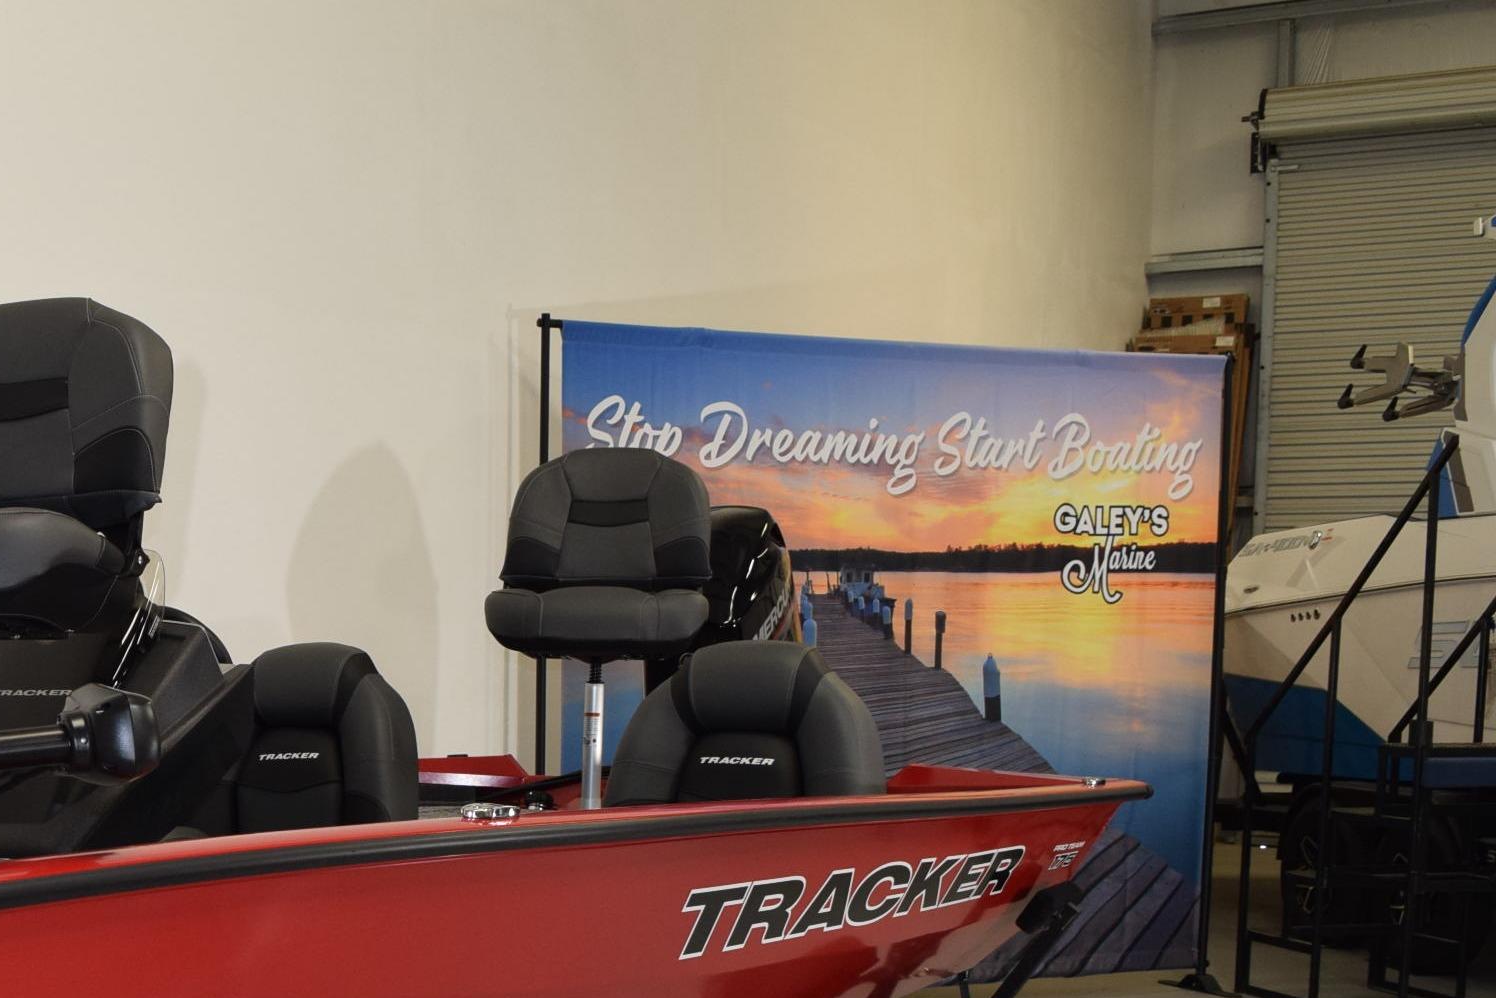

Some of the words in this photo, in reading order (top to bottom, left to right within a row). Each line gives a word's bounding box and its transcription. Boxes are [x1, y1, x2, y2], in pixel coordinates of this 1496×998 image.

[585, 395, 683, 457] Stop
[699, 401, 925, 496] Dreaming
[934, 411, 1046, 477] Start
[1048, 413, 1202, 501] Boating
[1054, 502, 1170, 537] GALEY'S
[1060, 536, 1156, 604] Marine
[258, 752, 320, 761] TRACKER
[699, 756, 776, 766] TRACKER
[678, 845, 1026, 960] TRACKER
